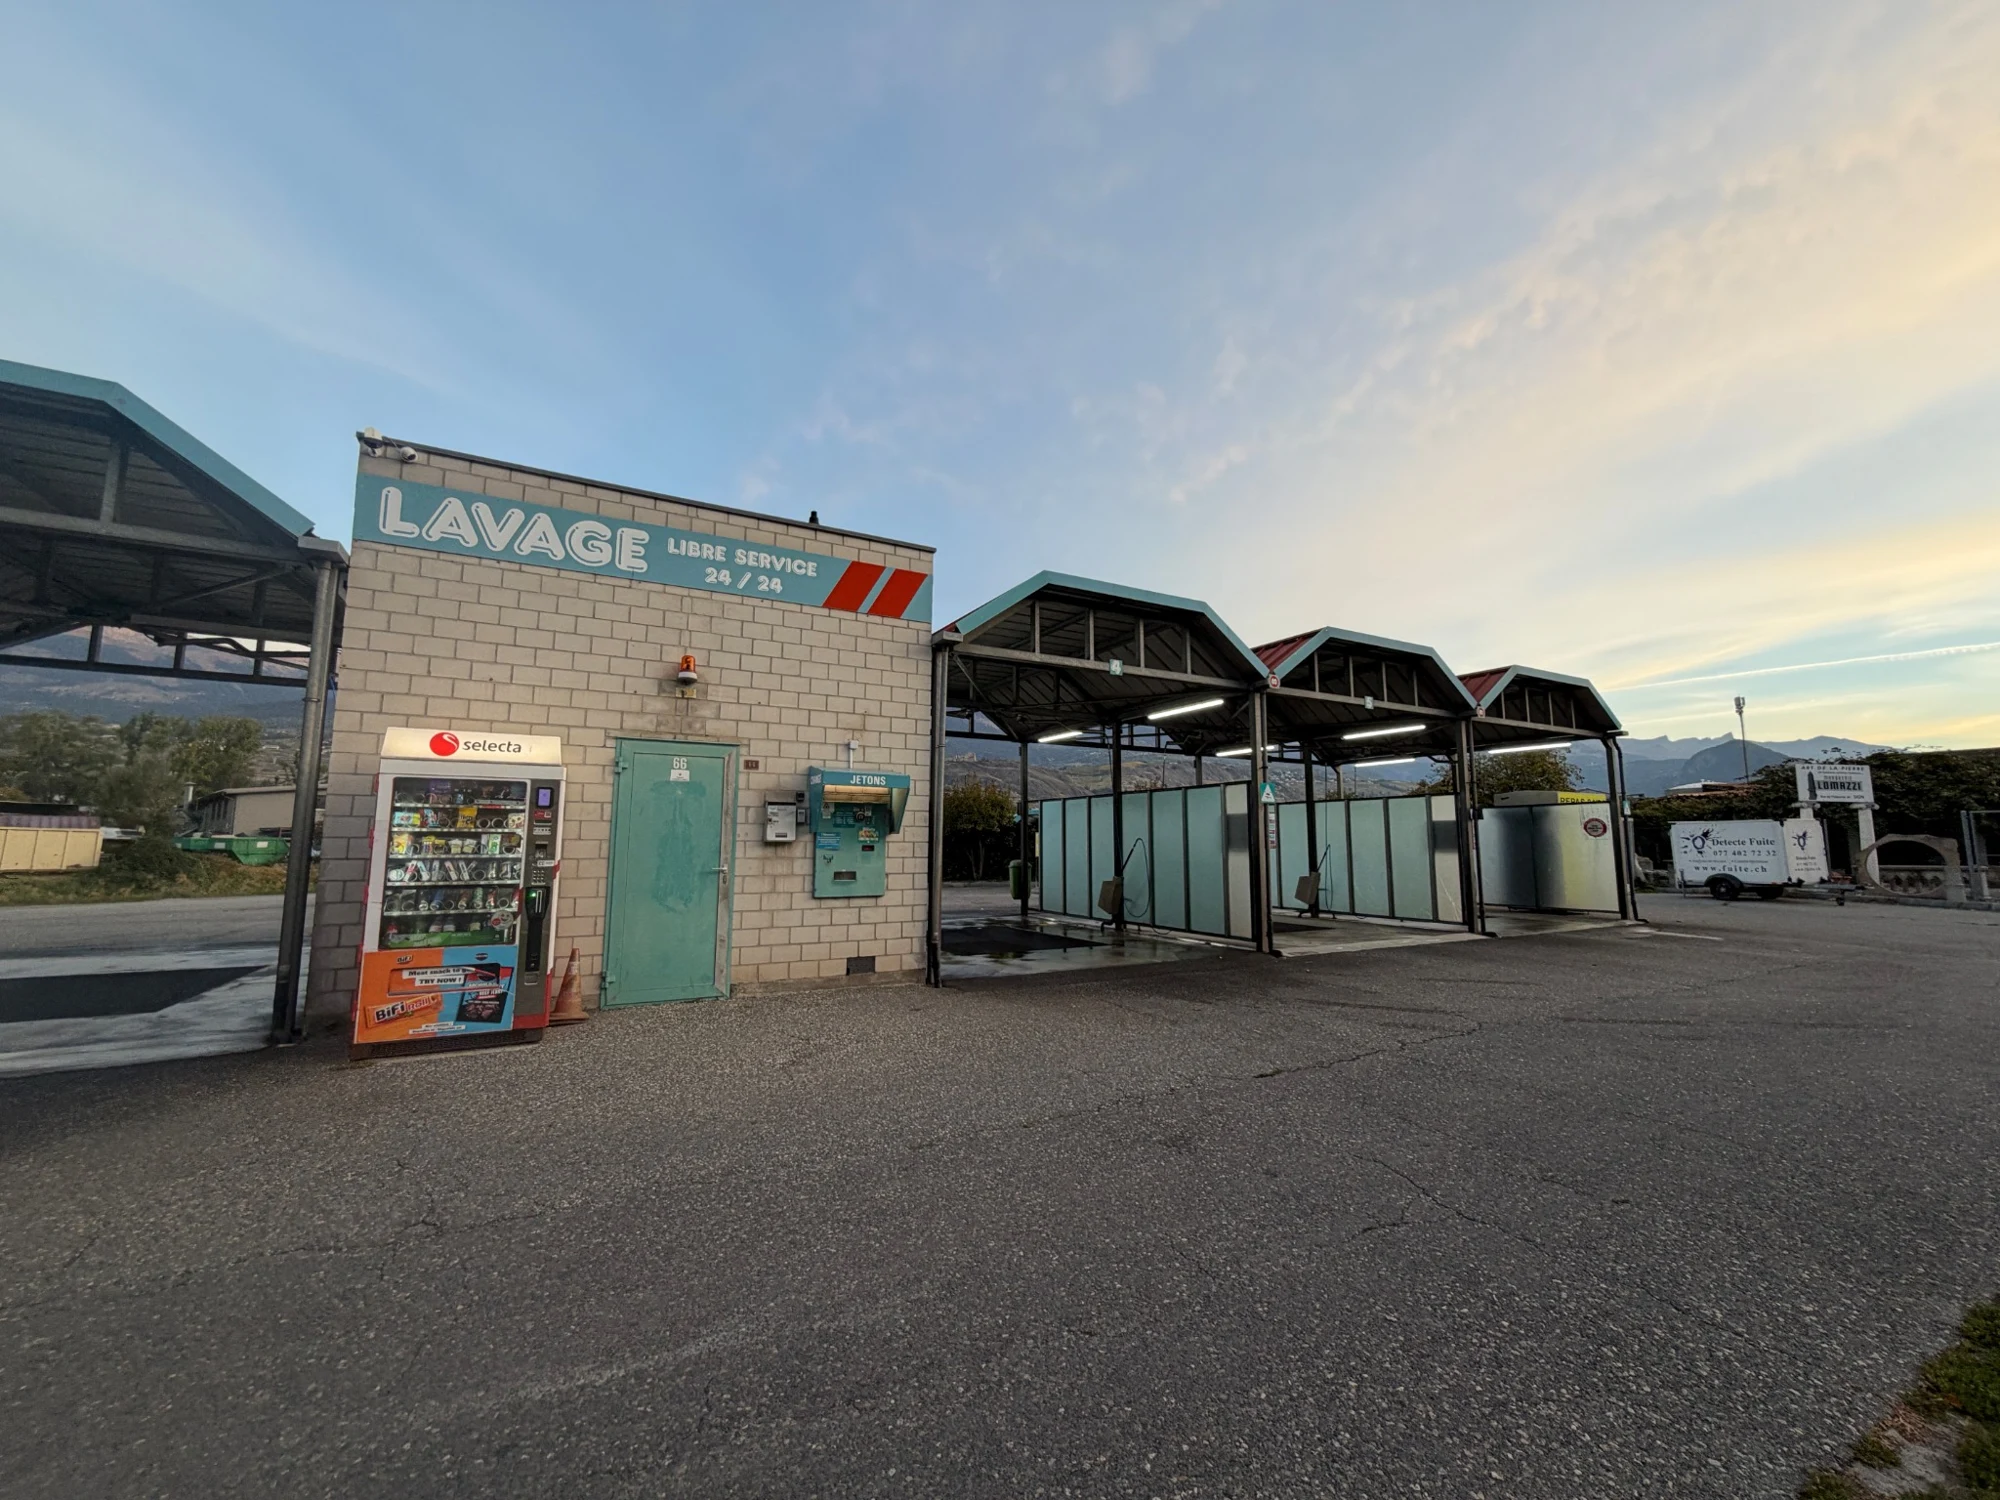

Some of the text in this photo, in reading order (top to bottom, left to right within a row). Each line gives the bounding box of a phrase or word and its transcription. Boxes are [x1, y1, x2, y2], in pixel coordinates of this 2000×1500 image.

[378, 486, 649, 573] LAVAGE
[667, 537, 818, 577] LIBRE SERVICE
[704, 566, 783, 594] 24 / 24
[462, 740, 522, 753] selecta
[673, 757, 687, 769] 66
[850, 775, 886, 785] JETONS
[1817, 781, 1862, 790] LOMAZZI
[1749, 838, 1775, 846] Fuite
[1694, 865, 1767, 873] www.fuite.ch
[375, 1001, 405, 1020] BiFi
